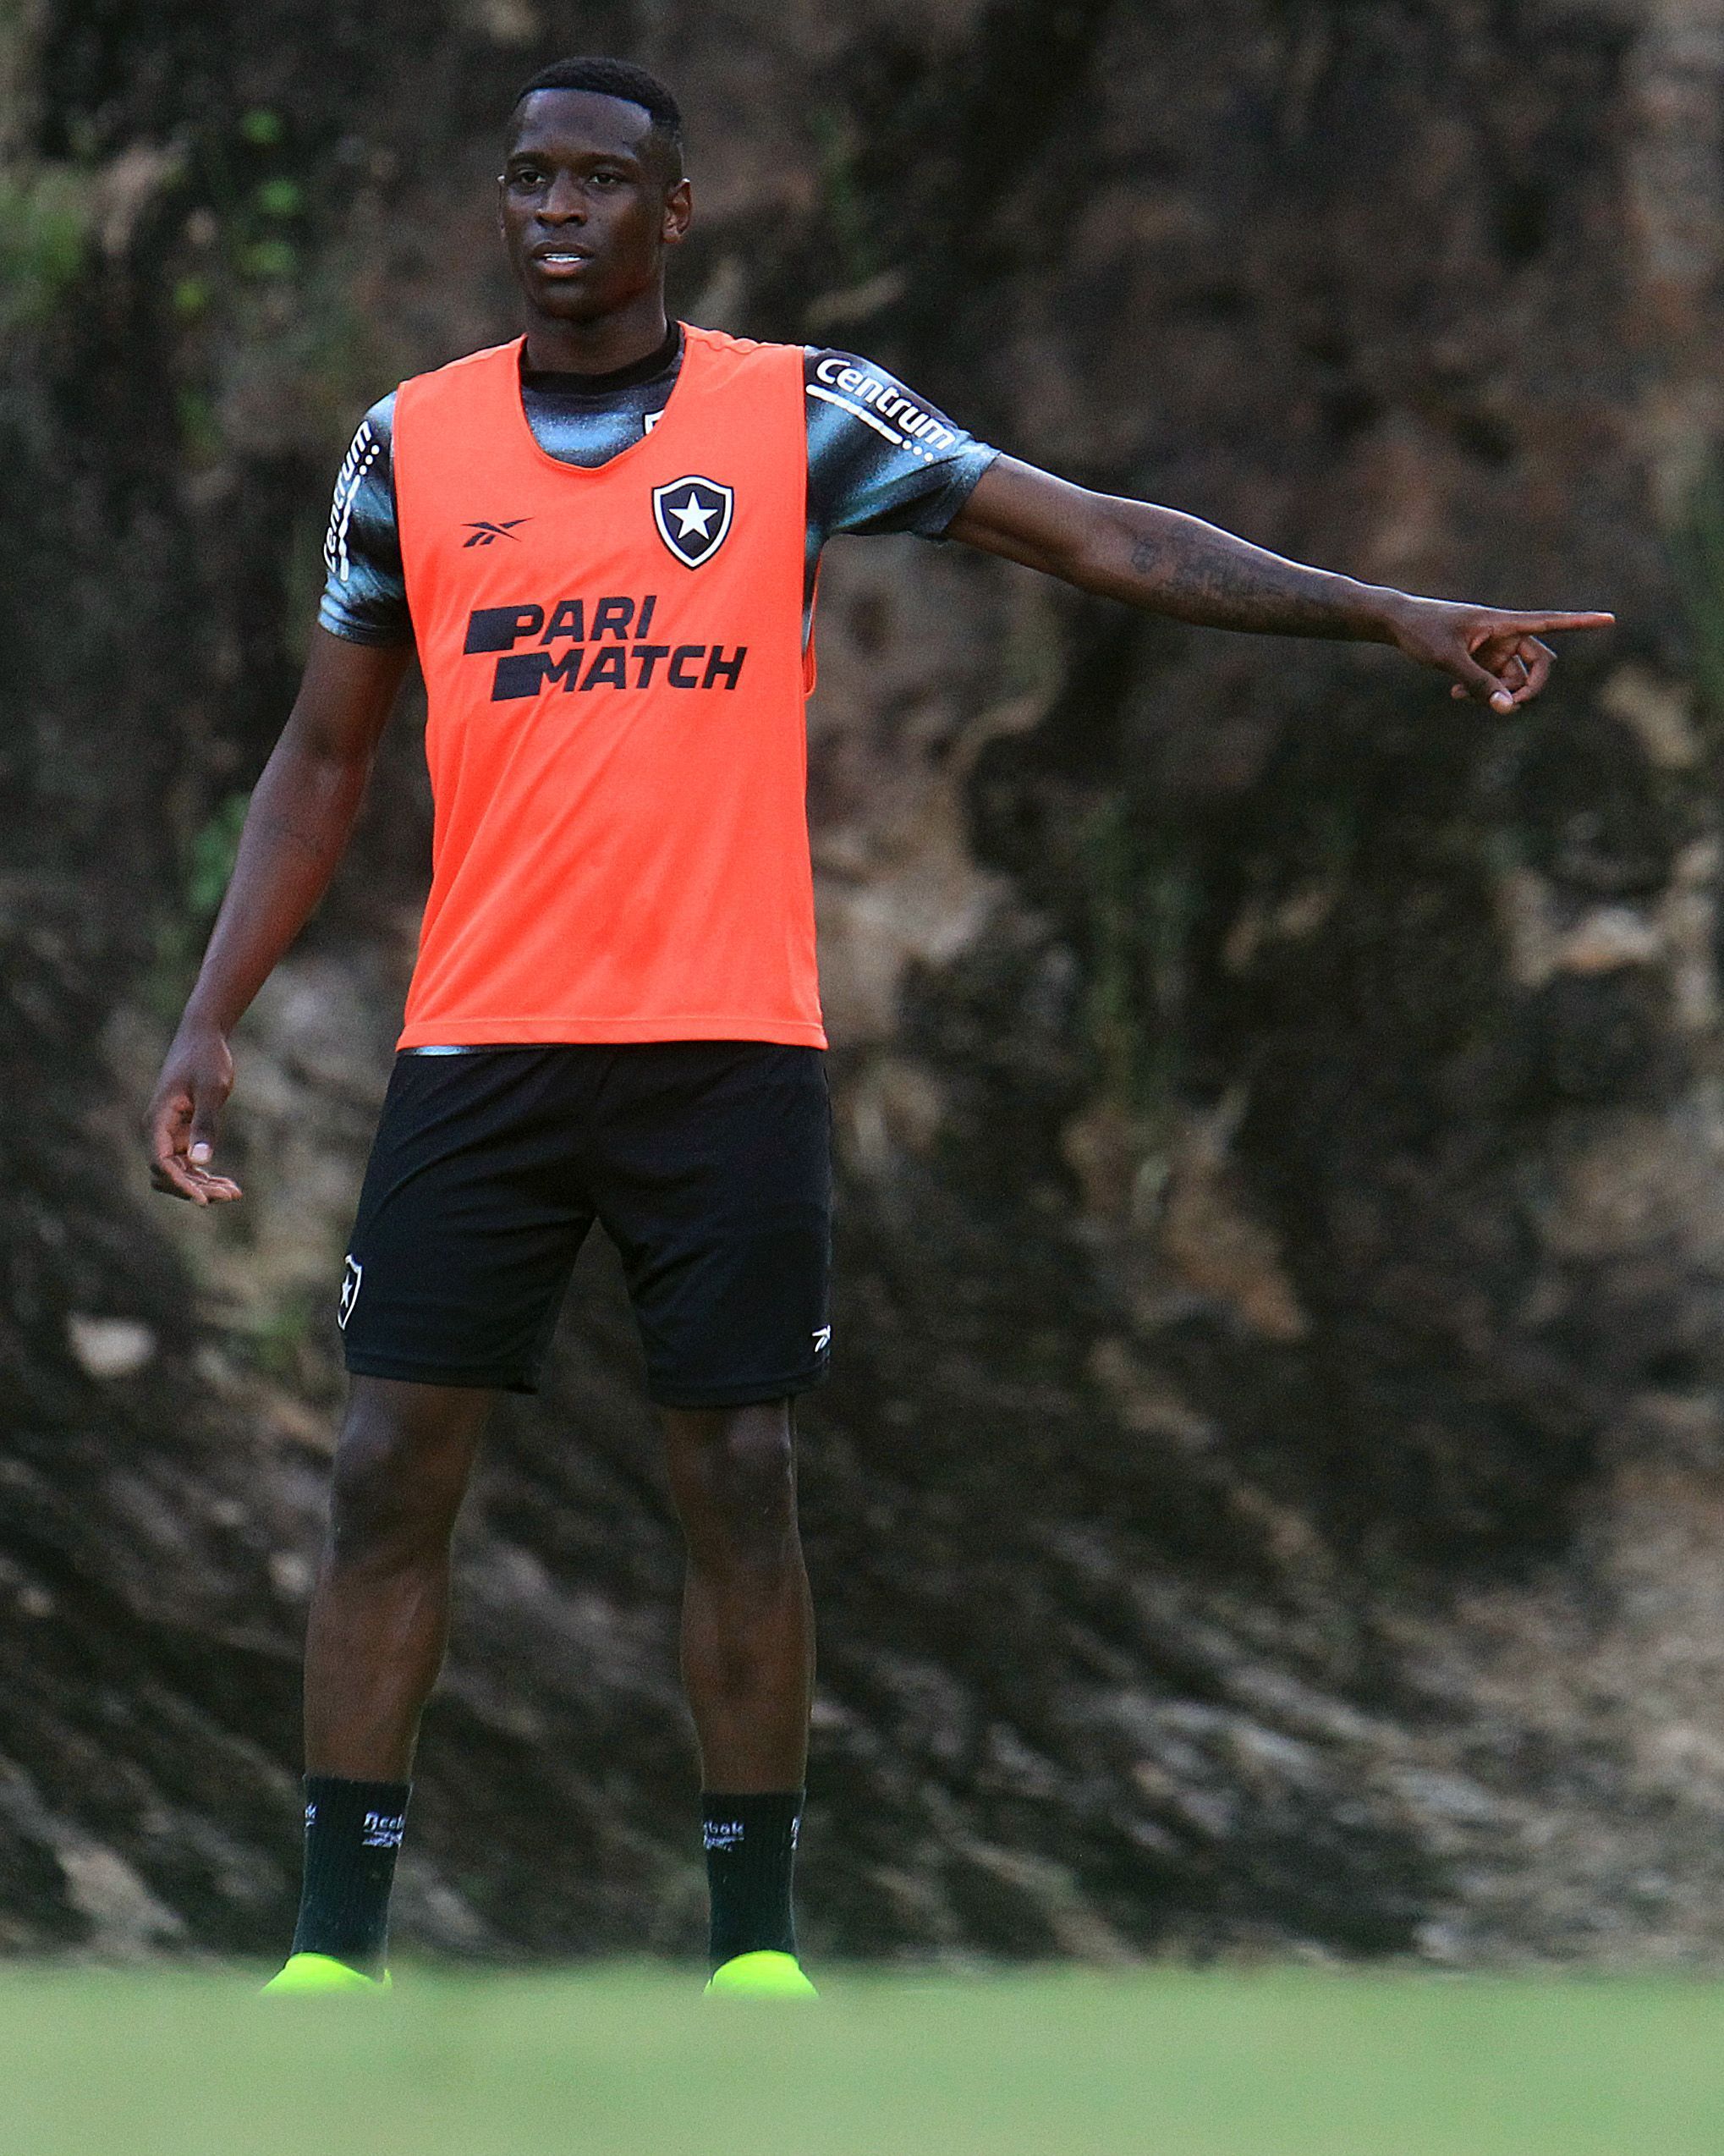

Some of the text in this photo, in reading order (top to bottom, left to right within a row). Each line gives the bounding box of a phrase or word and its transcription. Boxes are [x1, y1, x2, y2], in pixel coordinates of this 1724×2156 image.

[816, 357, 956, 450] Centrum
[323, 421, 372, 573] Centrum
[464, 595, 658, 655] PARI
[491, 644, 748, 701] MATCH
